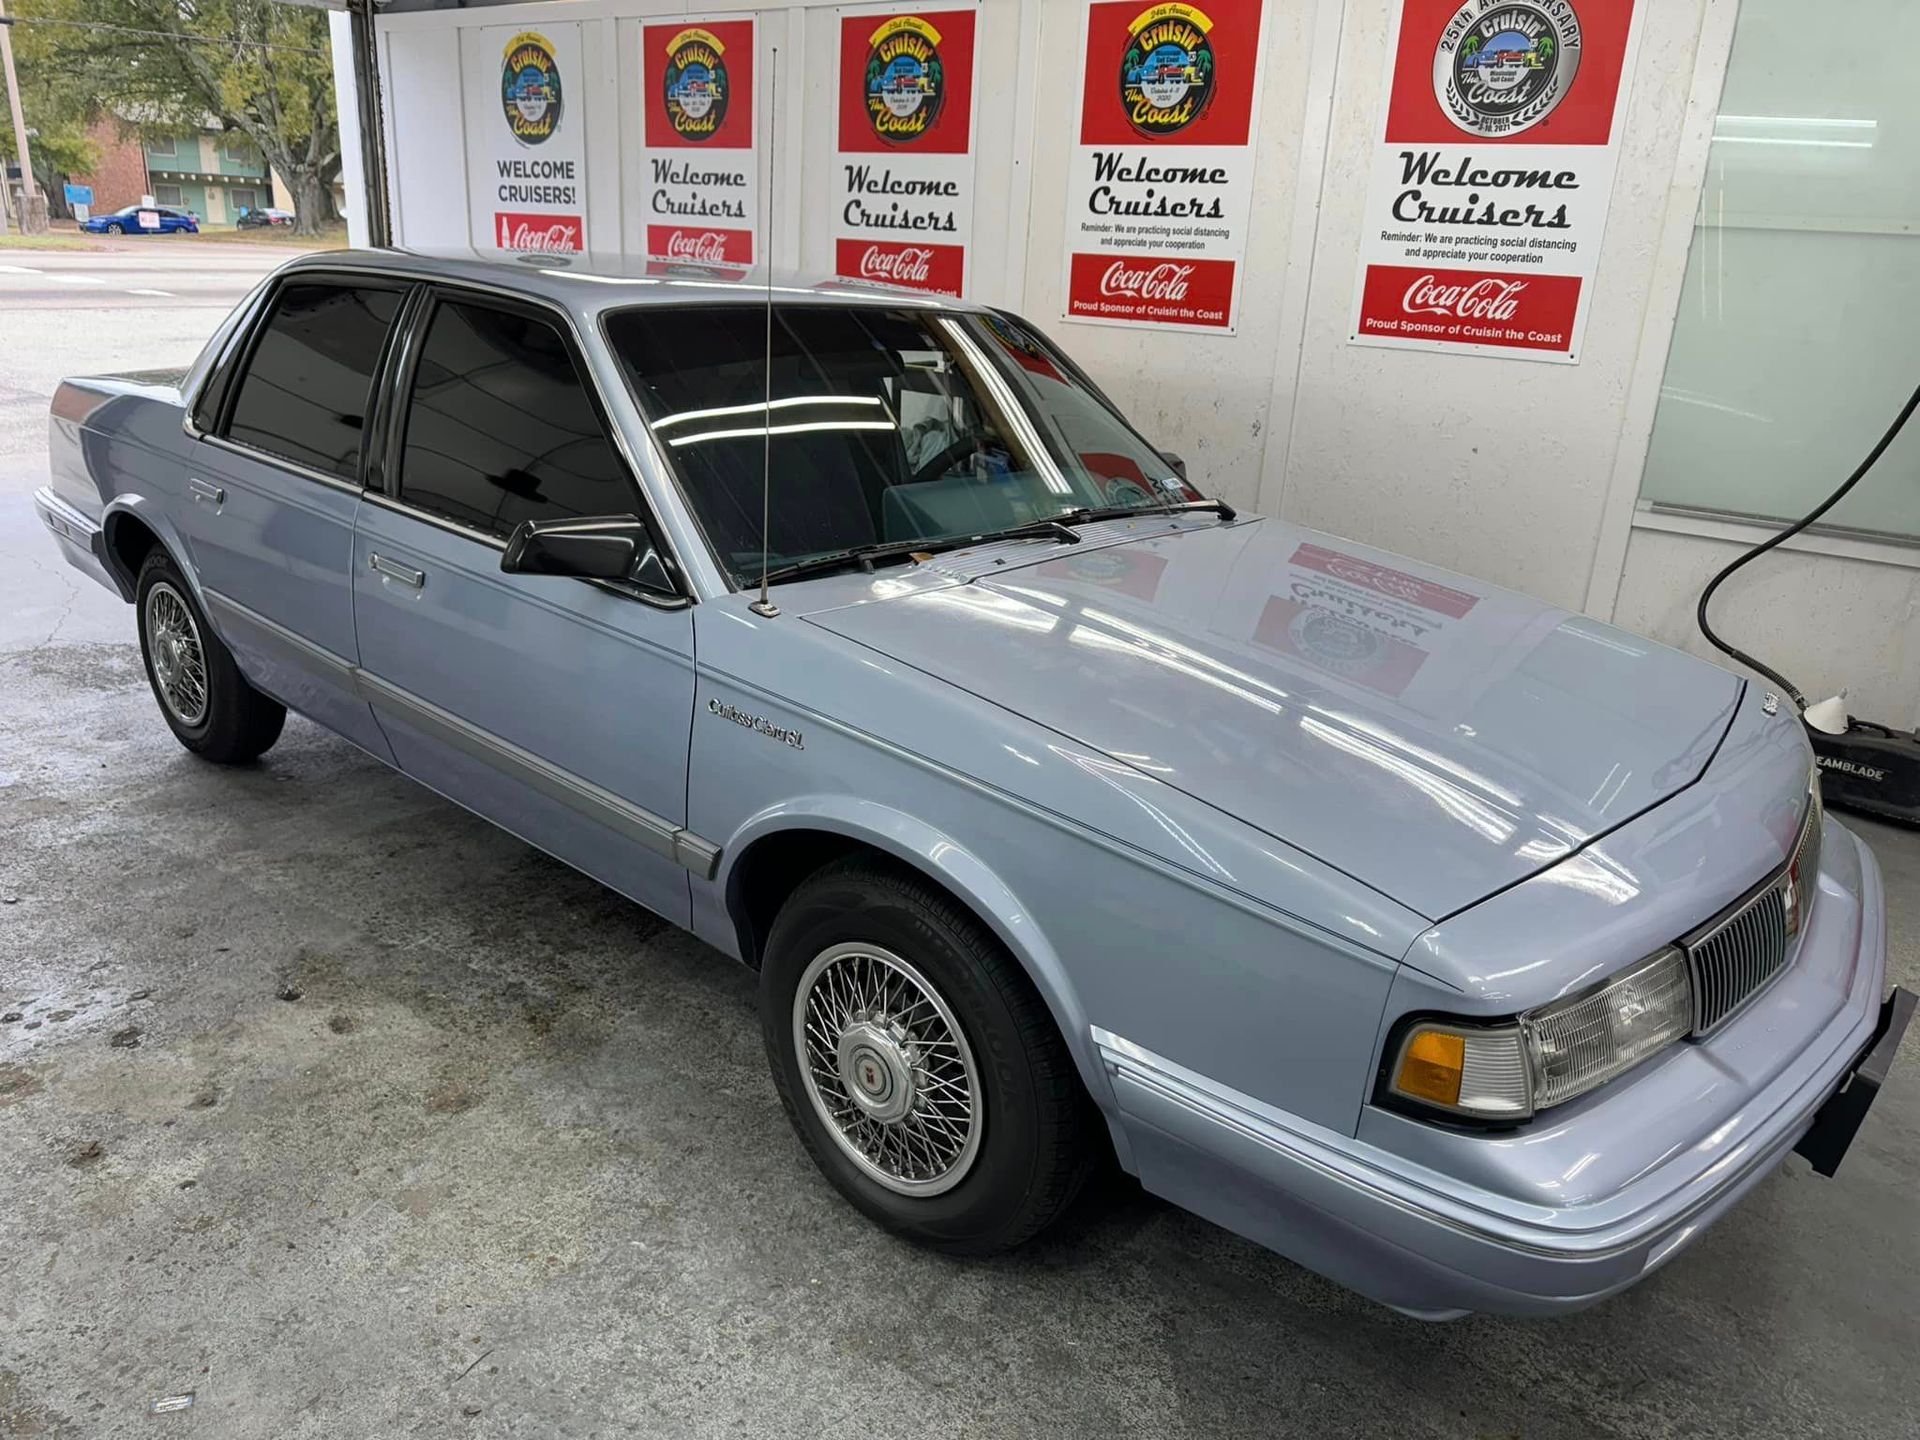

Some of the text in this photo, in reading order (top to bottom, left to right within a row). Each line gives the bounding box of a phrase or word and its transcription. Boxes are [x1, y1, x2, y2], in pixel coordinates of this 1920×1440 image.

[1140, 20, 1203, 51] Cruisin'
[1441, 11, 1472, 50] 25th
[1481, 10, 1546, 37] Cruisin'
[880, 33, 933, 62] Cruisin'
[1461, 72, 1479, 84] The
[868, 98, 884, 111] The
[1125, 88, 1142, 101] The
[1467, 80, 1532, 104] Coast
[514, 111, 552, 135] Coast
[675, 109, 715, 132] Coast
[876, 104, 928, 132] Coast
[1133, 97, 1193, 123] Coast
[497, 160, 575, 179] WELCOME
[651, 158, 747, 187] Welcome
[844, 165, 959, 196] Welcome
[1092, 152, 1228, 184] Welcome
[1399, 151, 1580, 189] Welcome
[498, 184, 576, 205] CRUISERS!
[652, 189, 746, 218] Cruisers
[1089, 185, 1224, 219] Cruisers
[843, 199, 957, 232] Cruisers
[1392, 189, 1572, 229] Cruisers
[1081, 222, 1112, 233] Reminder:
[1114, 224, 1124, 233] We
[1137, 225, 1171, 237] practicing
[1172, 227, 1192, 236] social
[1193, 228, 1230, 239] distancing
[1100, 237, 1205, 250] and appreciate your cooperation
[1380, 231, 1577, 253] Reminder: We are practicing social distancing
[860, 245, 934, 281] Coca-Cola
[1405, 247, 1543, 264] and appreciate your cooperation
[1100, 261, 1197, 301] Coca-Cola
[1073, 300, 1098, 311] Proud
[1100, 302, 1134, 314] Sponsor
[1136, 304, 1147, 314] of
[1180, 308, 1194, 318] the
[1196, 309, 1223, 320] Coast
[1402, 275, 1530, 321] Coca-Cola
[1366, 318, 1398, 330] Proud
[1400, 320, 1444, 334] Sponsor
[1447, 323, 1460, 334] of
[1505, 328, 1524, 340] the
[1527, 330, 1562, 343] Coast
